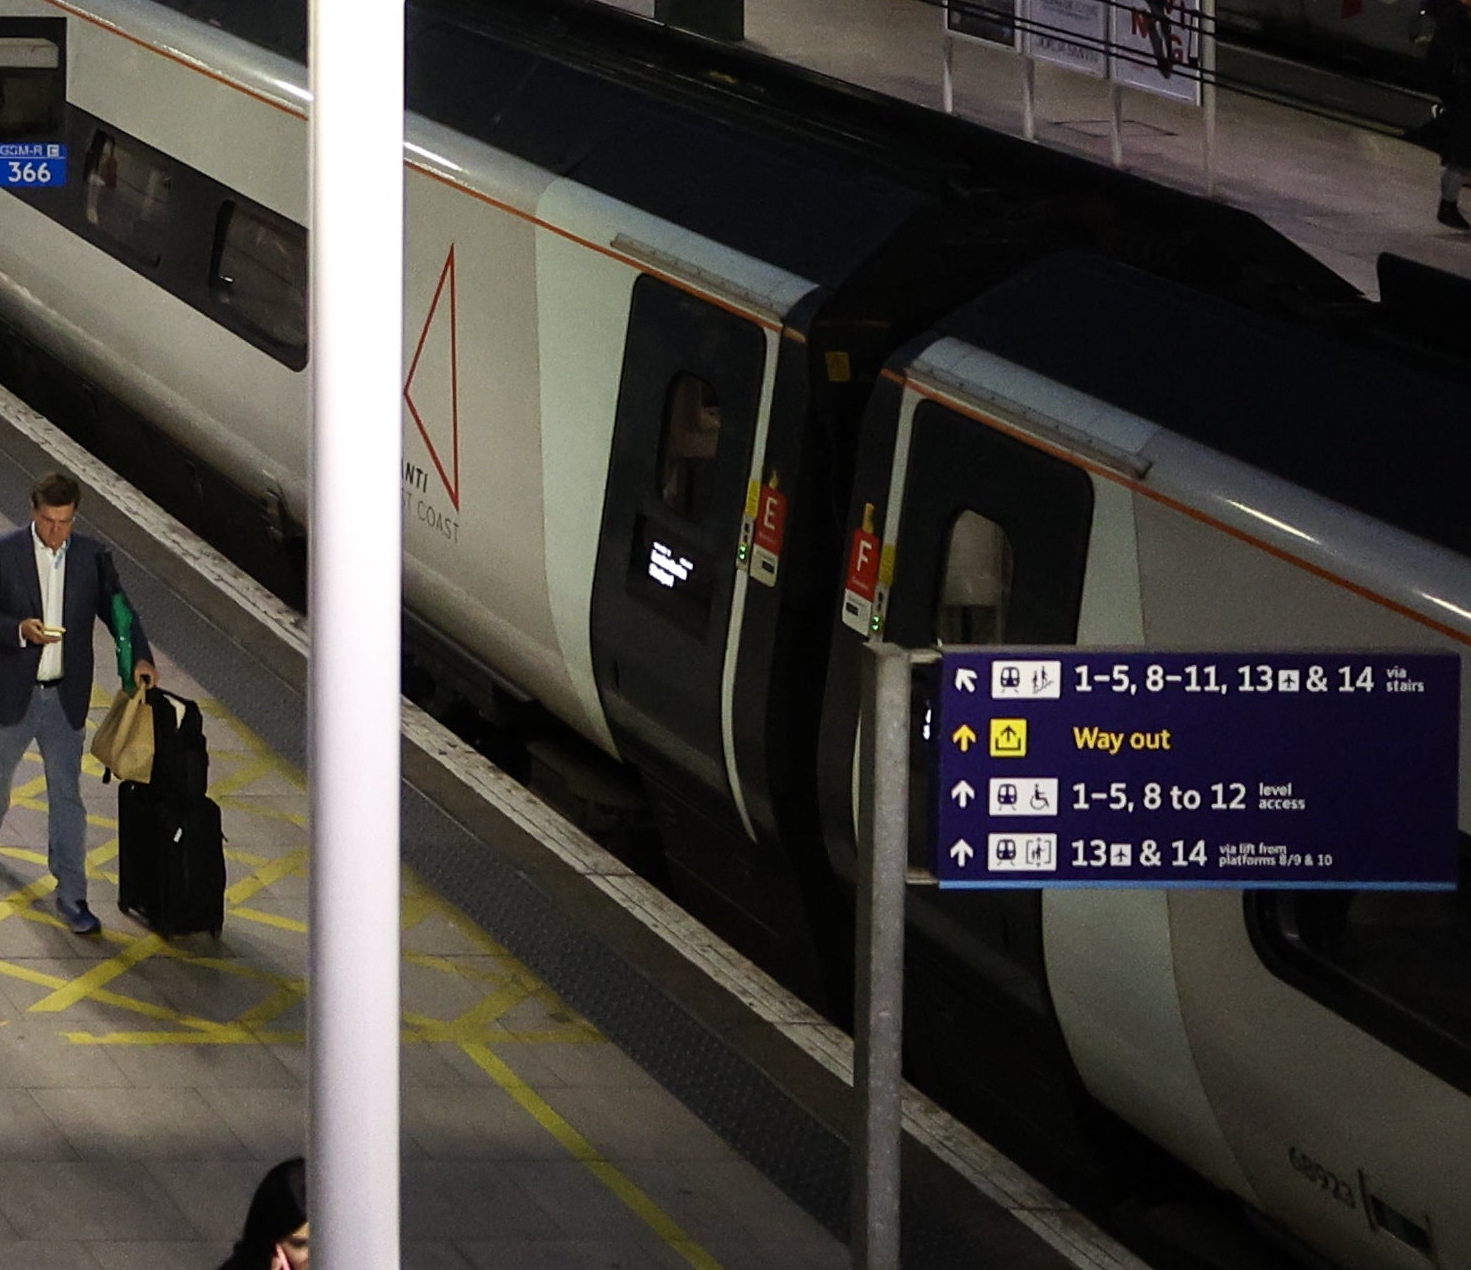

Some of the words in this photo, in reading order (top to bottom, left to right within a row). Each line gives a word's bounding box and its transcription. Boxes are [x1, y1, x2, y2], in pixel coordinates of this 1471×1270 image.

[7, 161, 51, 183] 366
[401, 458, 428, 494] NTI
[417, 499, 460, 544] COAST
[763, 496, 781, 531] E
[856, 539, 873, 572] F
[1237, 665, 1274, 693] 13
[1305, 665, 1329, 692] &
[1337, 665, 1375, 693] 14
[1385, 667, 1408, 680] via
[1385, 679, 1425, 693] stairs
[1073, 726, 1125, 756] Way
[1130, 729, 1172, 751] out
[1142, 782, 1163, 811] 8
[1170, 785, 1201, 811] to
[1210, 782, 1247, 811] 12
[1258, 782, 1293, 797] level
[1258, 797, 1306, 811] access
[1071, 840, 1107, 867] 13
[1138, 839, 1162, 867] &
[1171, 839, 1208, 867] 14
[1218, 844, 1237, 857] via
[1239, 843, 1256, 856] lift
[1257, 843, 1288, 857] from
[1218, 852, 1278, 867] platforms
[1278, 852, 1303, 868] 8/9
[1304, 854, 1316, 867] &
[1318, 853, 1333, 866] 10
